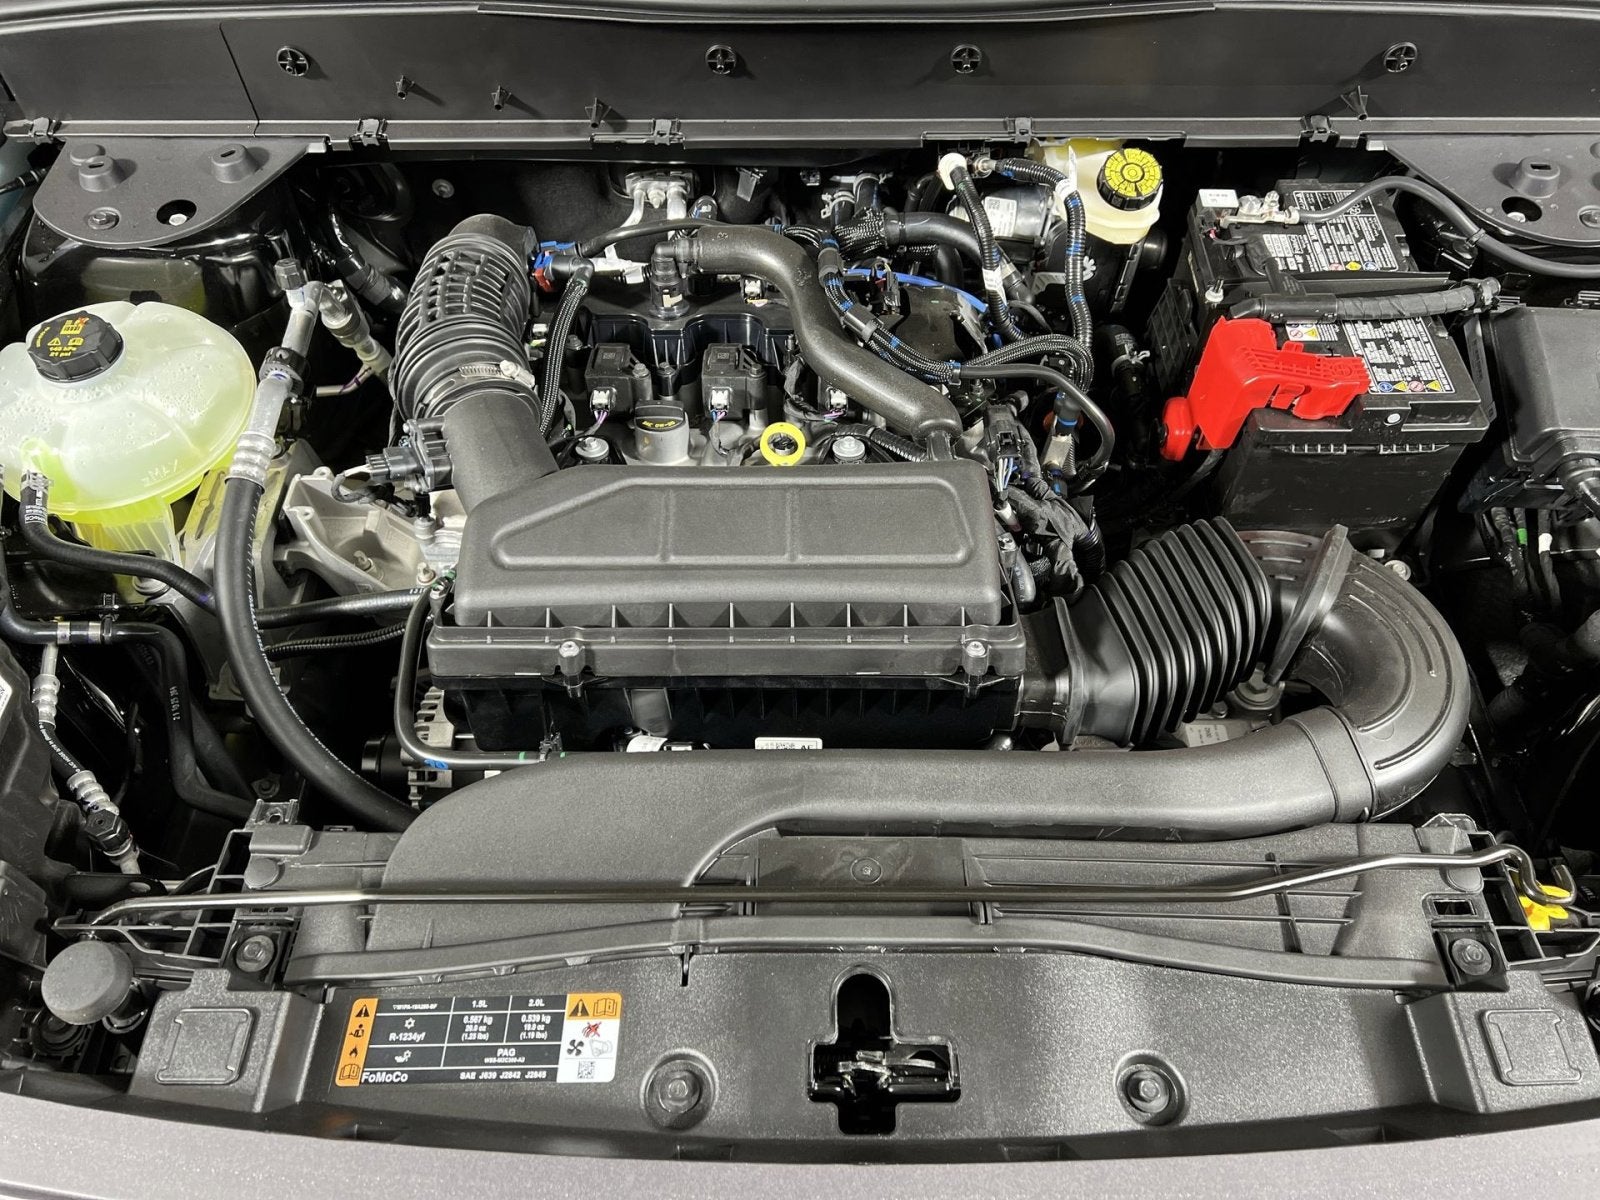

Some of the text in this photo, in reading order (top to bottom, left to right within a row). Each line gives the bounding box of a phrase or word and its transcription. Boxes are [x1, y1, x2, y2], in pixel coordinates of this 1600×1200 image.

[472, 1000, 488, 1009] 1.5L
[528, 999, 545, 1007] 2.0L
[482, 1015, 493, 1025] kg
[521, 1014, 551, 1024] 0.539 kg
[389, 1032, 426, 1042] R-1234yf
[476, 1032, 489, 1041] lbs)
[535, 1031, 548, 1040] lbs)
[497, 1048, 516, 1056] PAG
[361, 1071, 408, 1083] FoMoCo
[460, 1071, 476, 1080] SAE
[479, 1071, 497, 1080] J639
